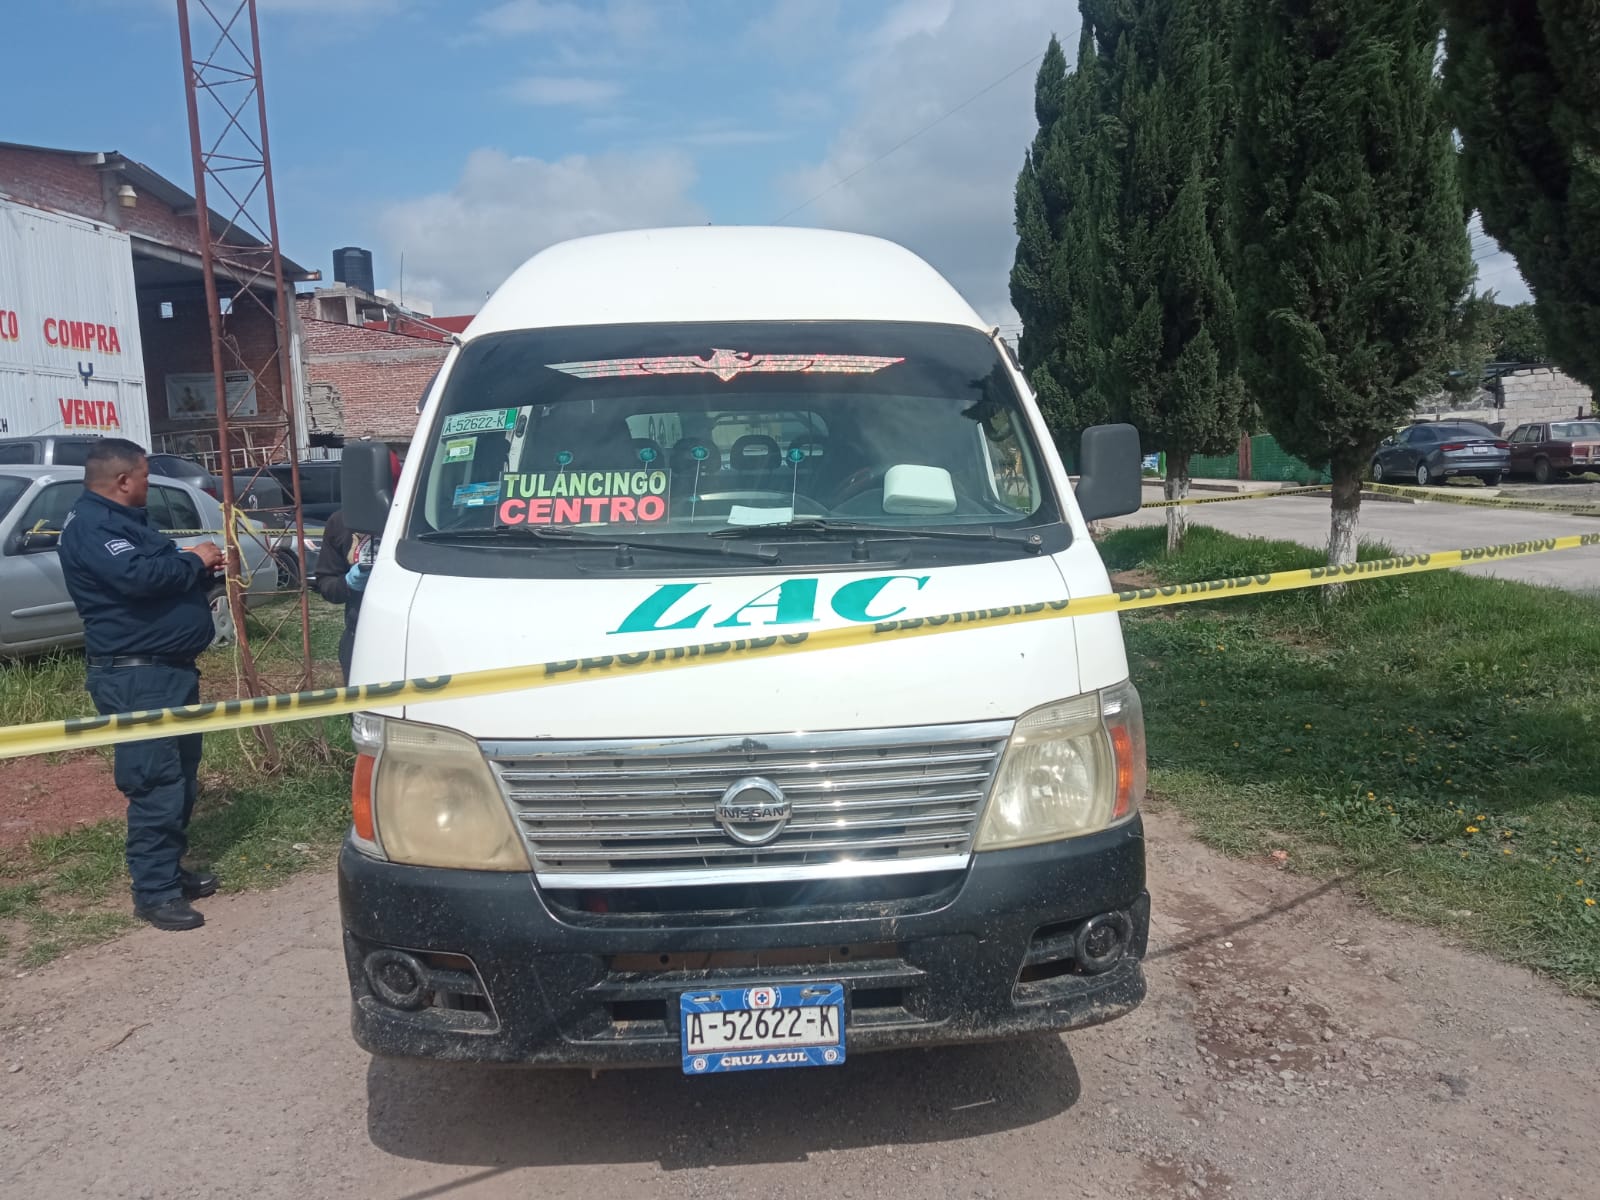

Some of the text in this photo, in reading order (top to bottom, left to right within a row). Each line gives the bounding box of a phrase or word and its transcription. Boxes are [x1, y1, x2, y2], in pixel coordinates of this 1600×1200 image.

[43, 317, 121, 353] COMPRA
[78, 361, 94, 387] Y
[59, 398, 120, 429] VENTA
[444, 415, 505, 433] A-52622-K
[503, 471, 667, 498] TULANCINGO
[499, 495, 666, 525] CENTRO
[606, 576, 931, 635] LAC
[720, 806, 785, 819] NISSAN
[690, 1005, 835, 1045] A-52622-K
[720, 1052, 809, 1067] CRUZ AZUL
